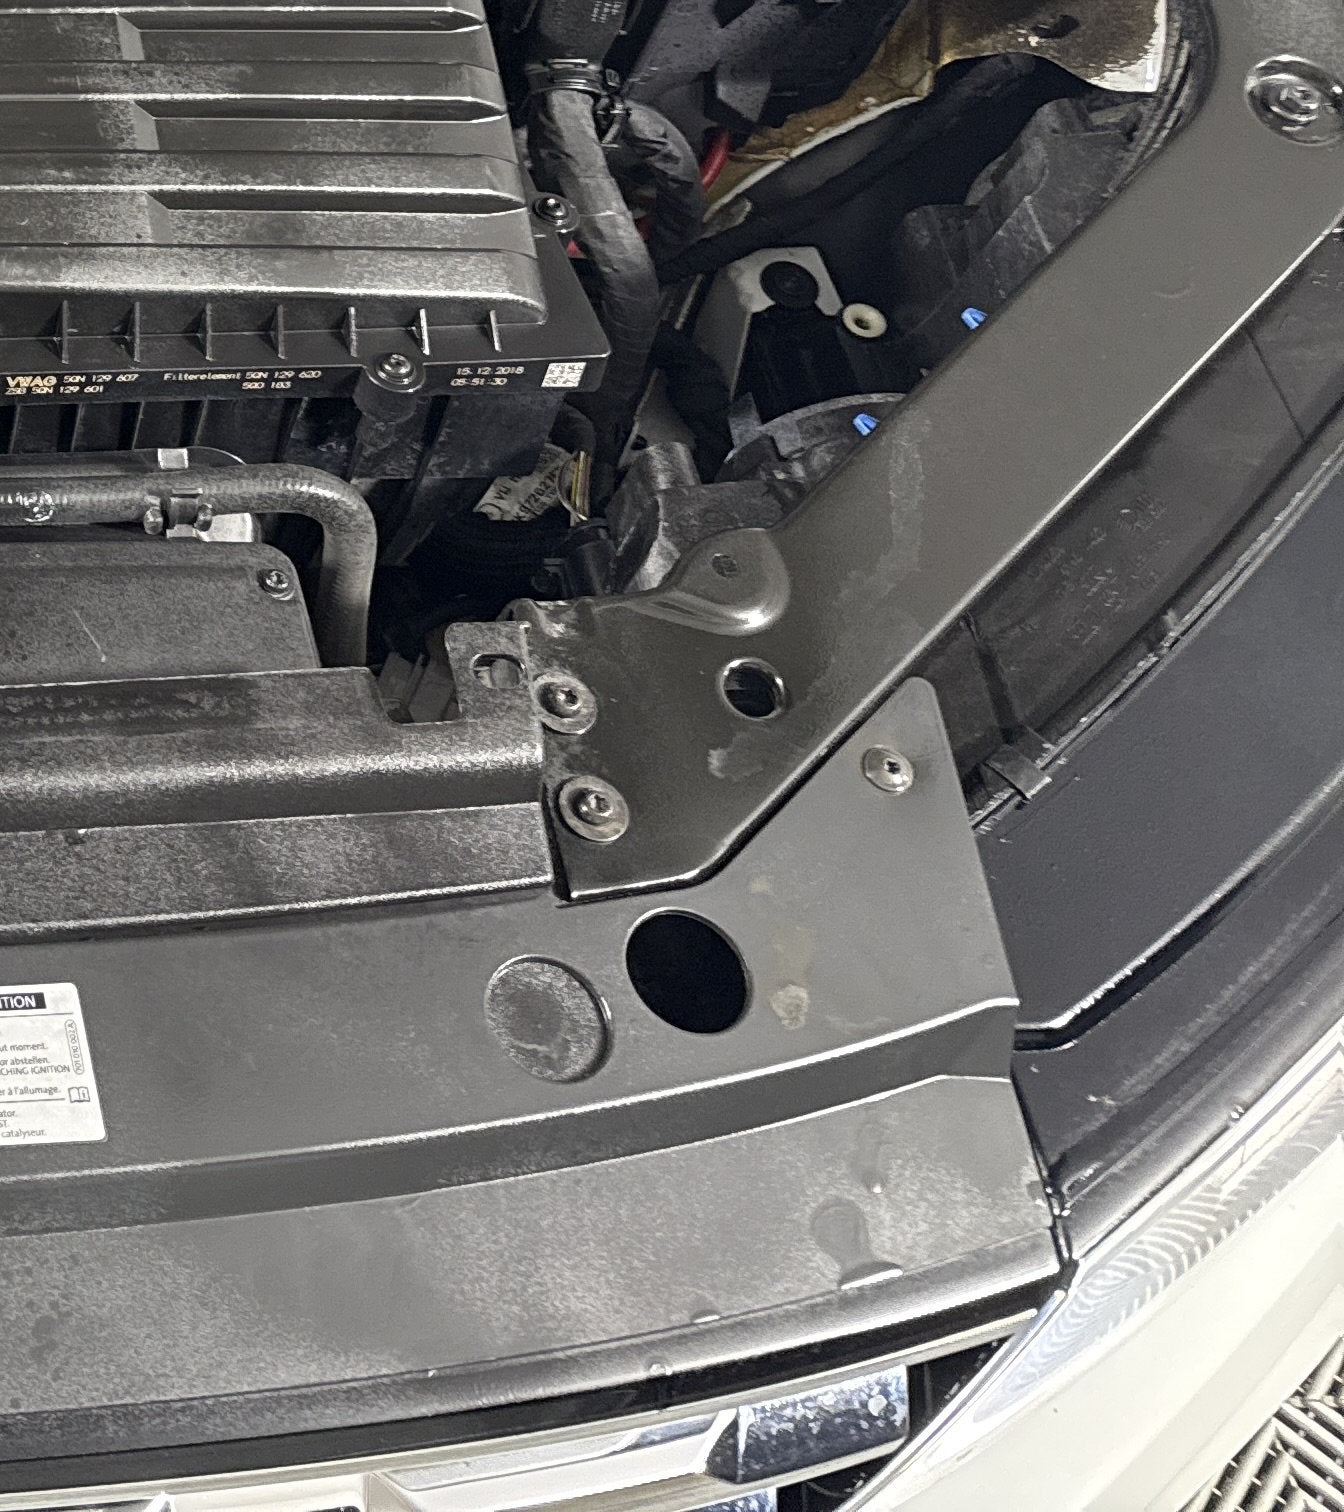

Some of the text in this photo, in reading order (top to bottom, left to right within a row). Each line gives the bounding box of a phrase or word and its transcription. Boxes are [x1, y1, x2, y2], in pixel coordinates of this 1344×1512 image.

[91, 374, 112, 382] 129
[163, 371, 242, 380] Filterelement
[274, 370, 294, 378] 129
[59, 385, 79, 393] 129
[83, 385, 103, 393] 601
[29, 1064, 70, 1074] IGNITION
